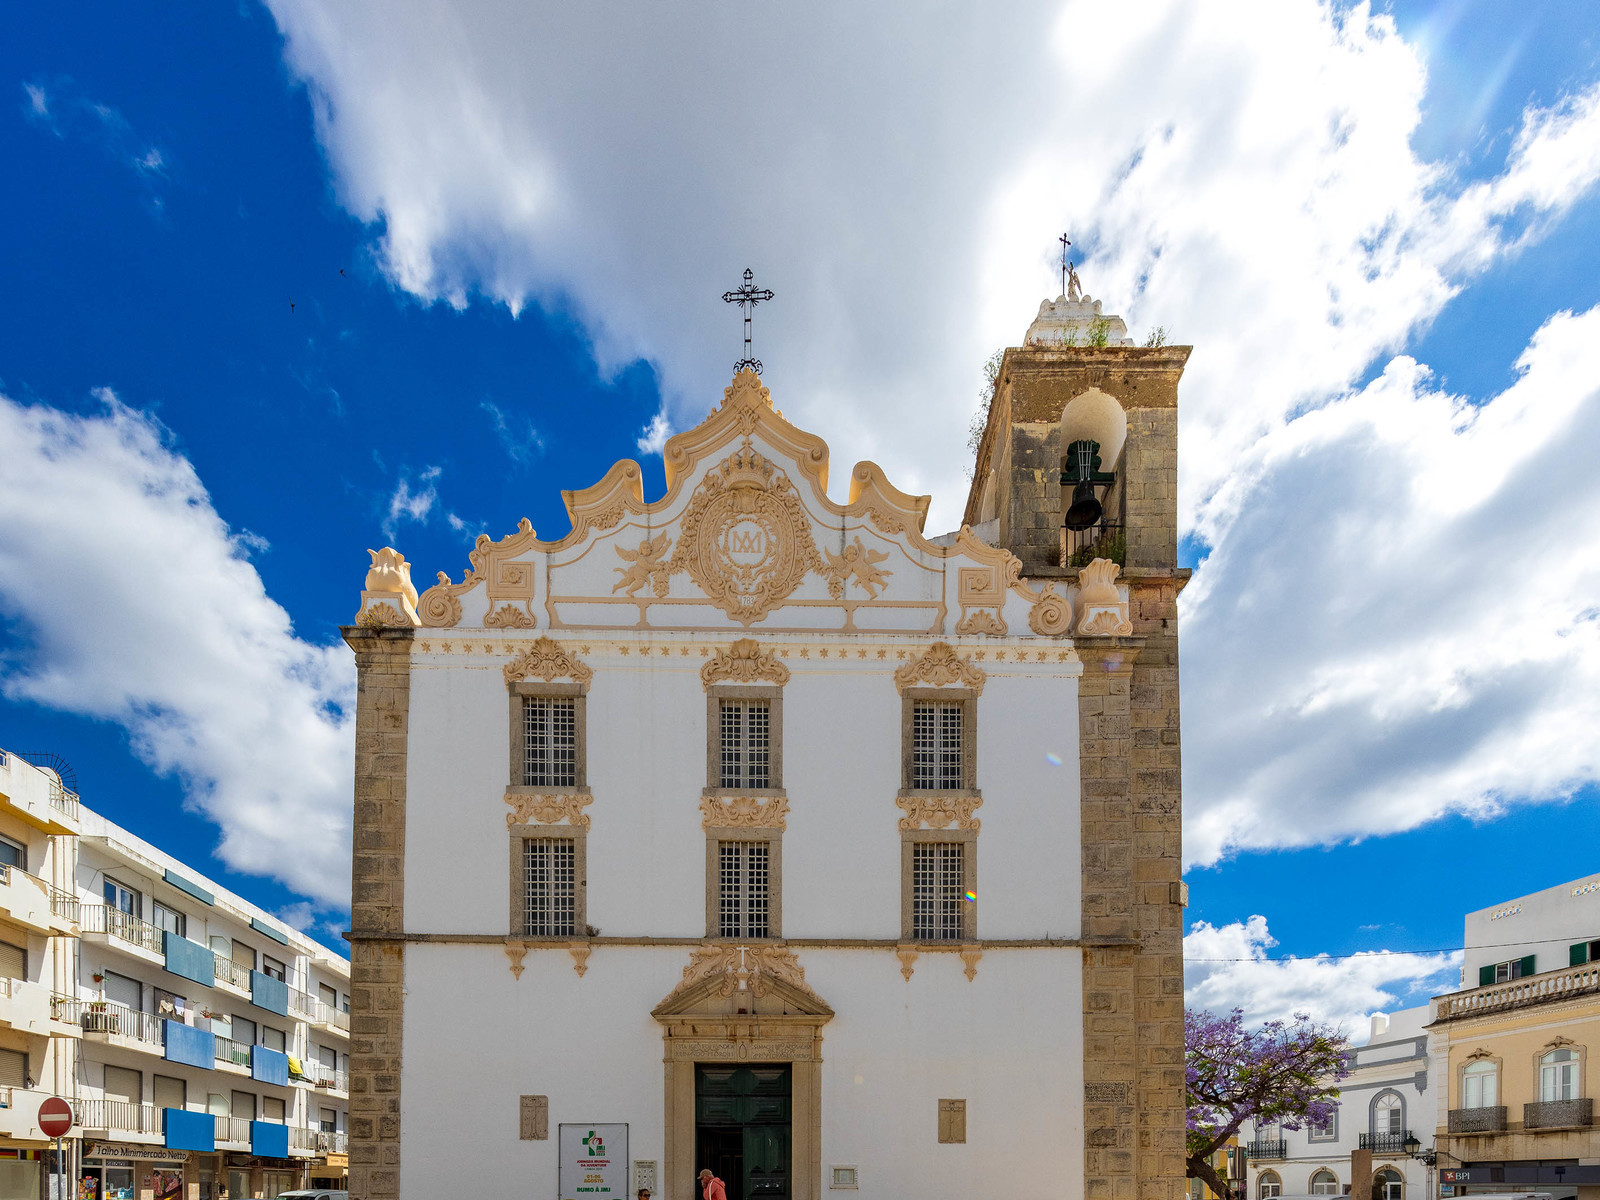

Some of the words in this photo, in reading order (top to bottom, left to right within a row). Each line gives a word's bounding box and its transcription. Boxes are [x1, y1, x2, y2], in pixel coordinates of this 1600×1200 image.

[96, 1145, 119, 1155] Talho
[120, 1147, 167, 1159] Minimercado
[168, 1151, 187, 1160] Netto
[1455, 1172, 1470, 1180] BPI
